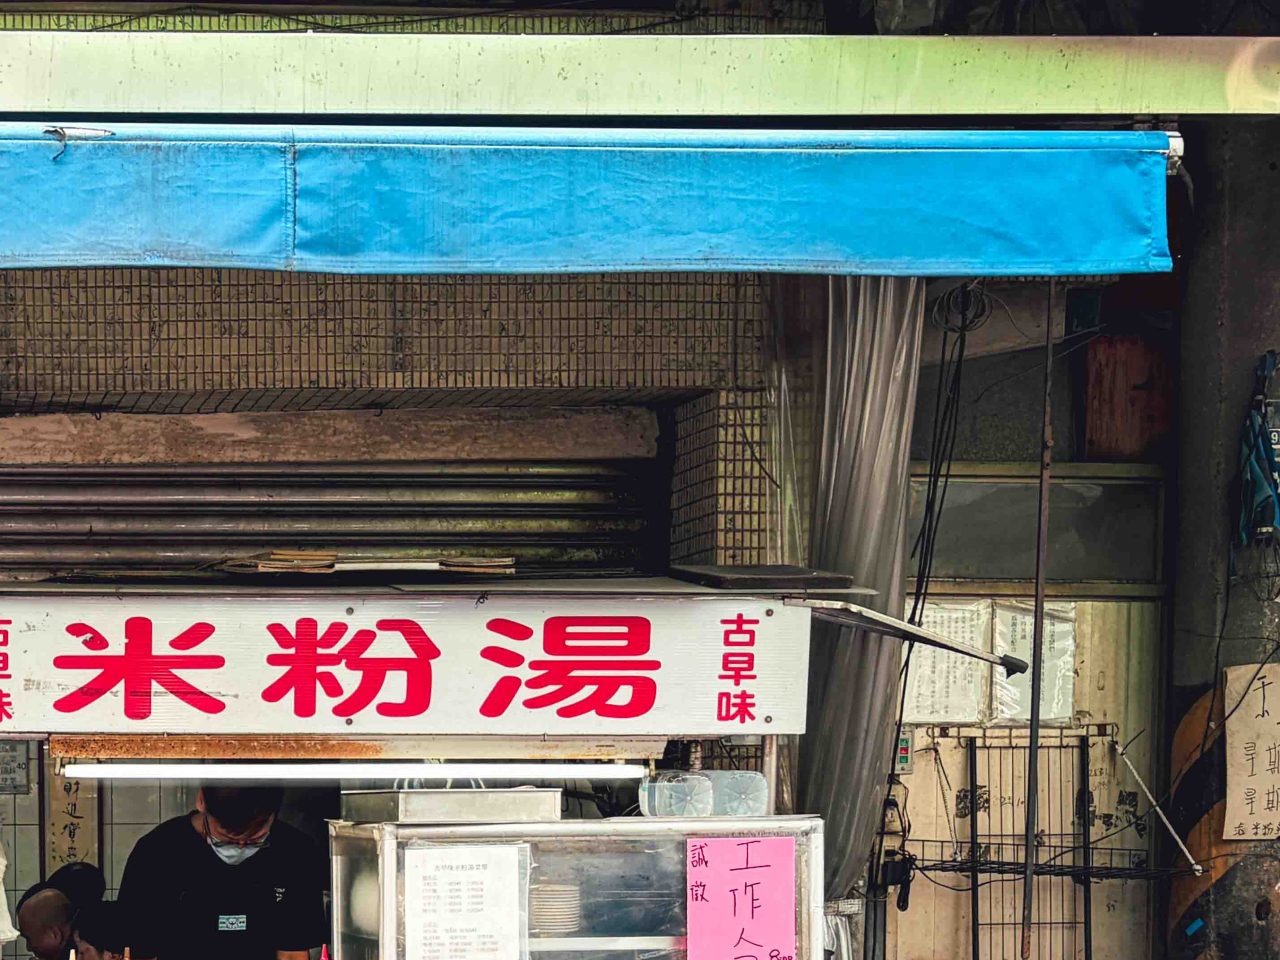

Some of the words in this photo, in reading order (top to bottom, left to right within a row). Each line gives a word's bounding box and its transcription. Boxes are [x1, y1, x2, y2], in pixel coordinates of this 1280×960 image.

[52, 616, 662, 720] 米粉湯
[716, 612, 760, 724] 古早味
[690, 842, 709, 902] 誠徵
